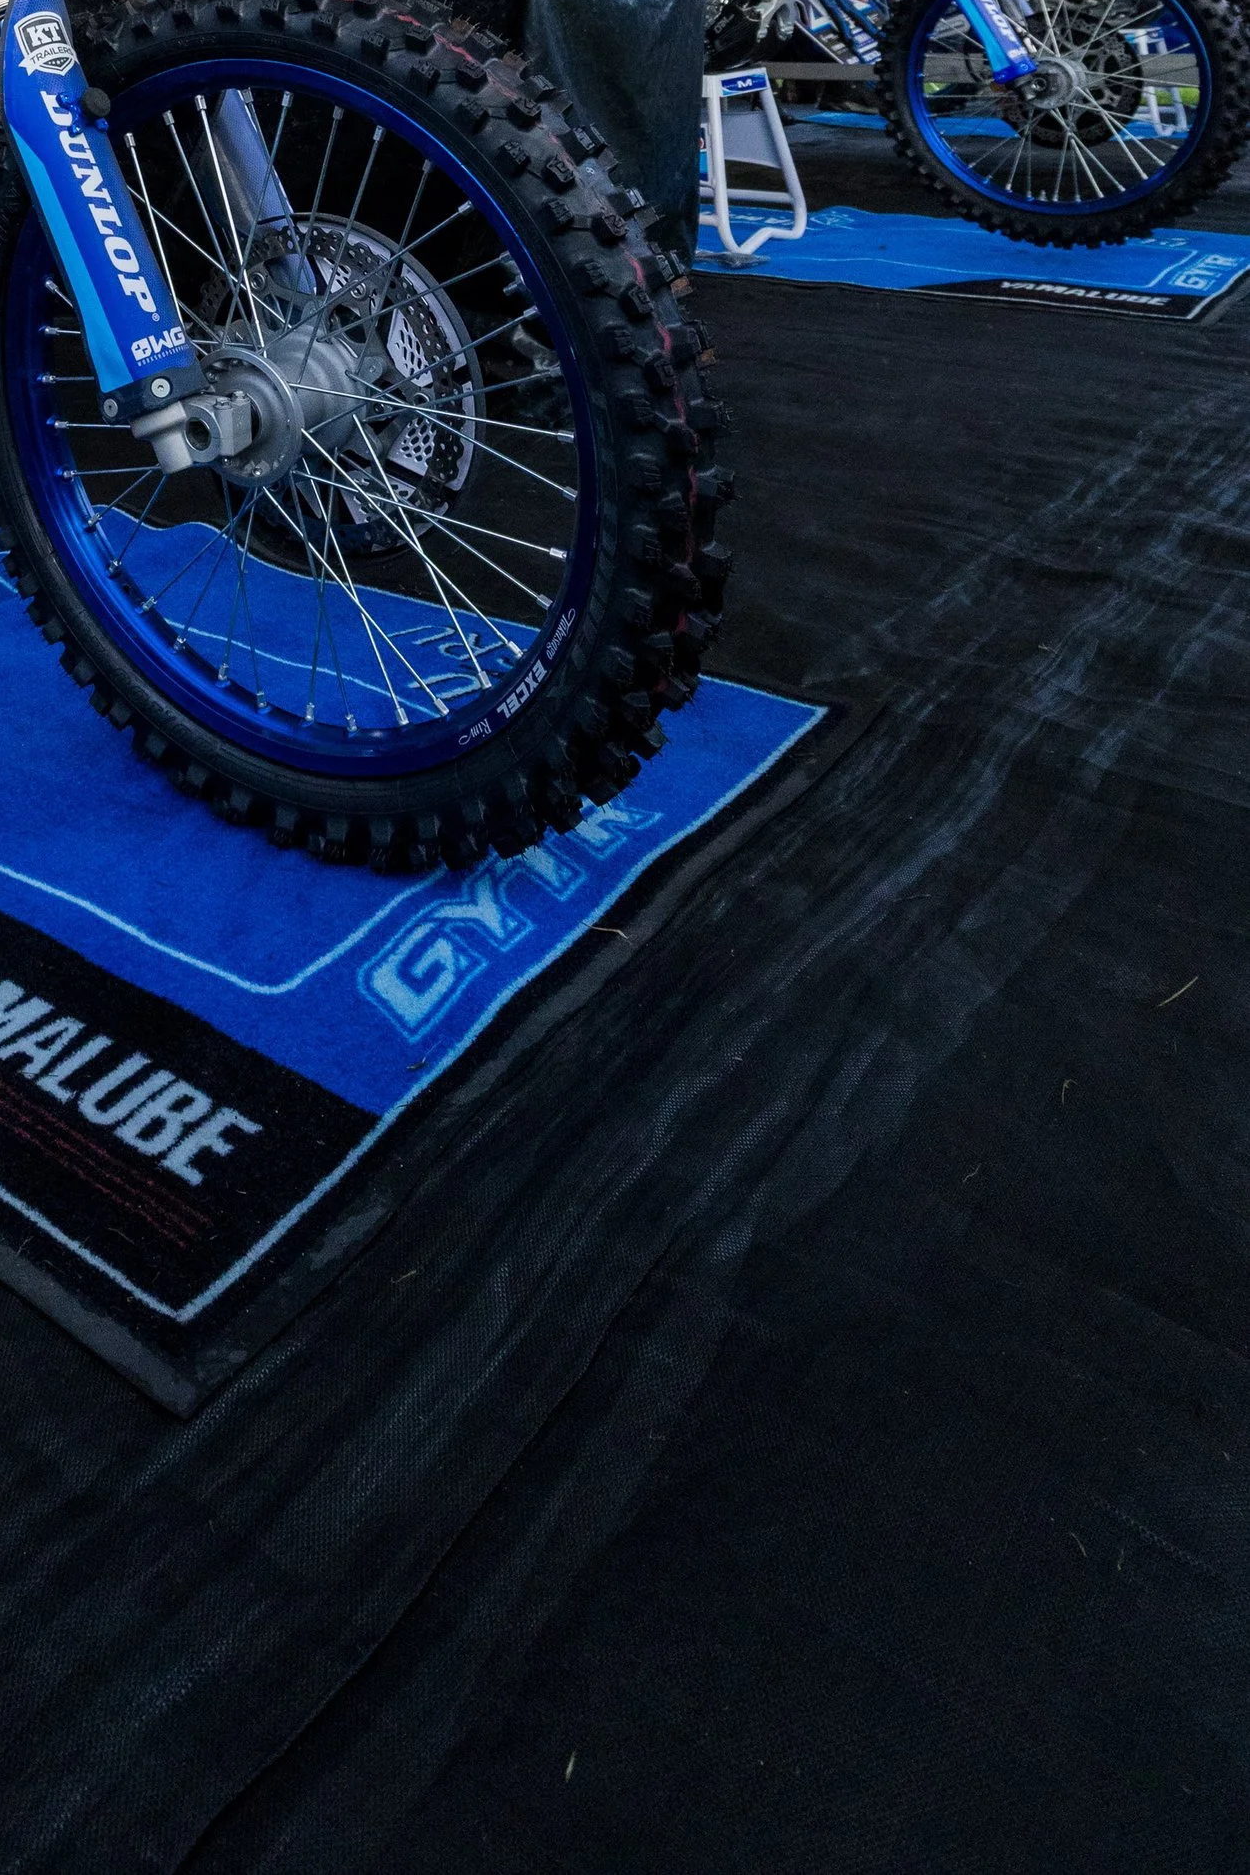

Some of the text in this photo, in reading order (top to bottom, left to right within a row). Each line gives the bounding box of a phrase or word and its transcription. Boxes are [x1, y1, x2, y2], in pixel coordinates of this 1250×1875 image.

[30, 22, 63, 46] KT
[40, 89, 156, 314] DUNLOP
[1170, 254, 1242, 290] GYTR
[999, 280, 1172, 307] YAMALUBE
[137, 343, 190, 368] WORKSHOPGRAPHICS
[497, 659, 548, 719] EXCEL
[458, 718, 492, 746] Rim
